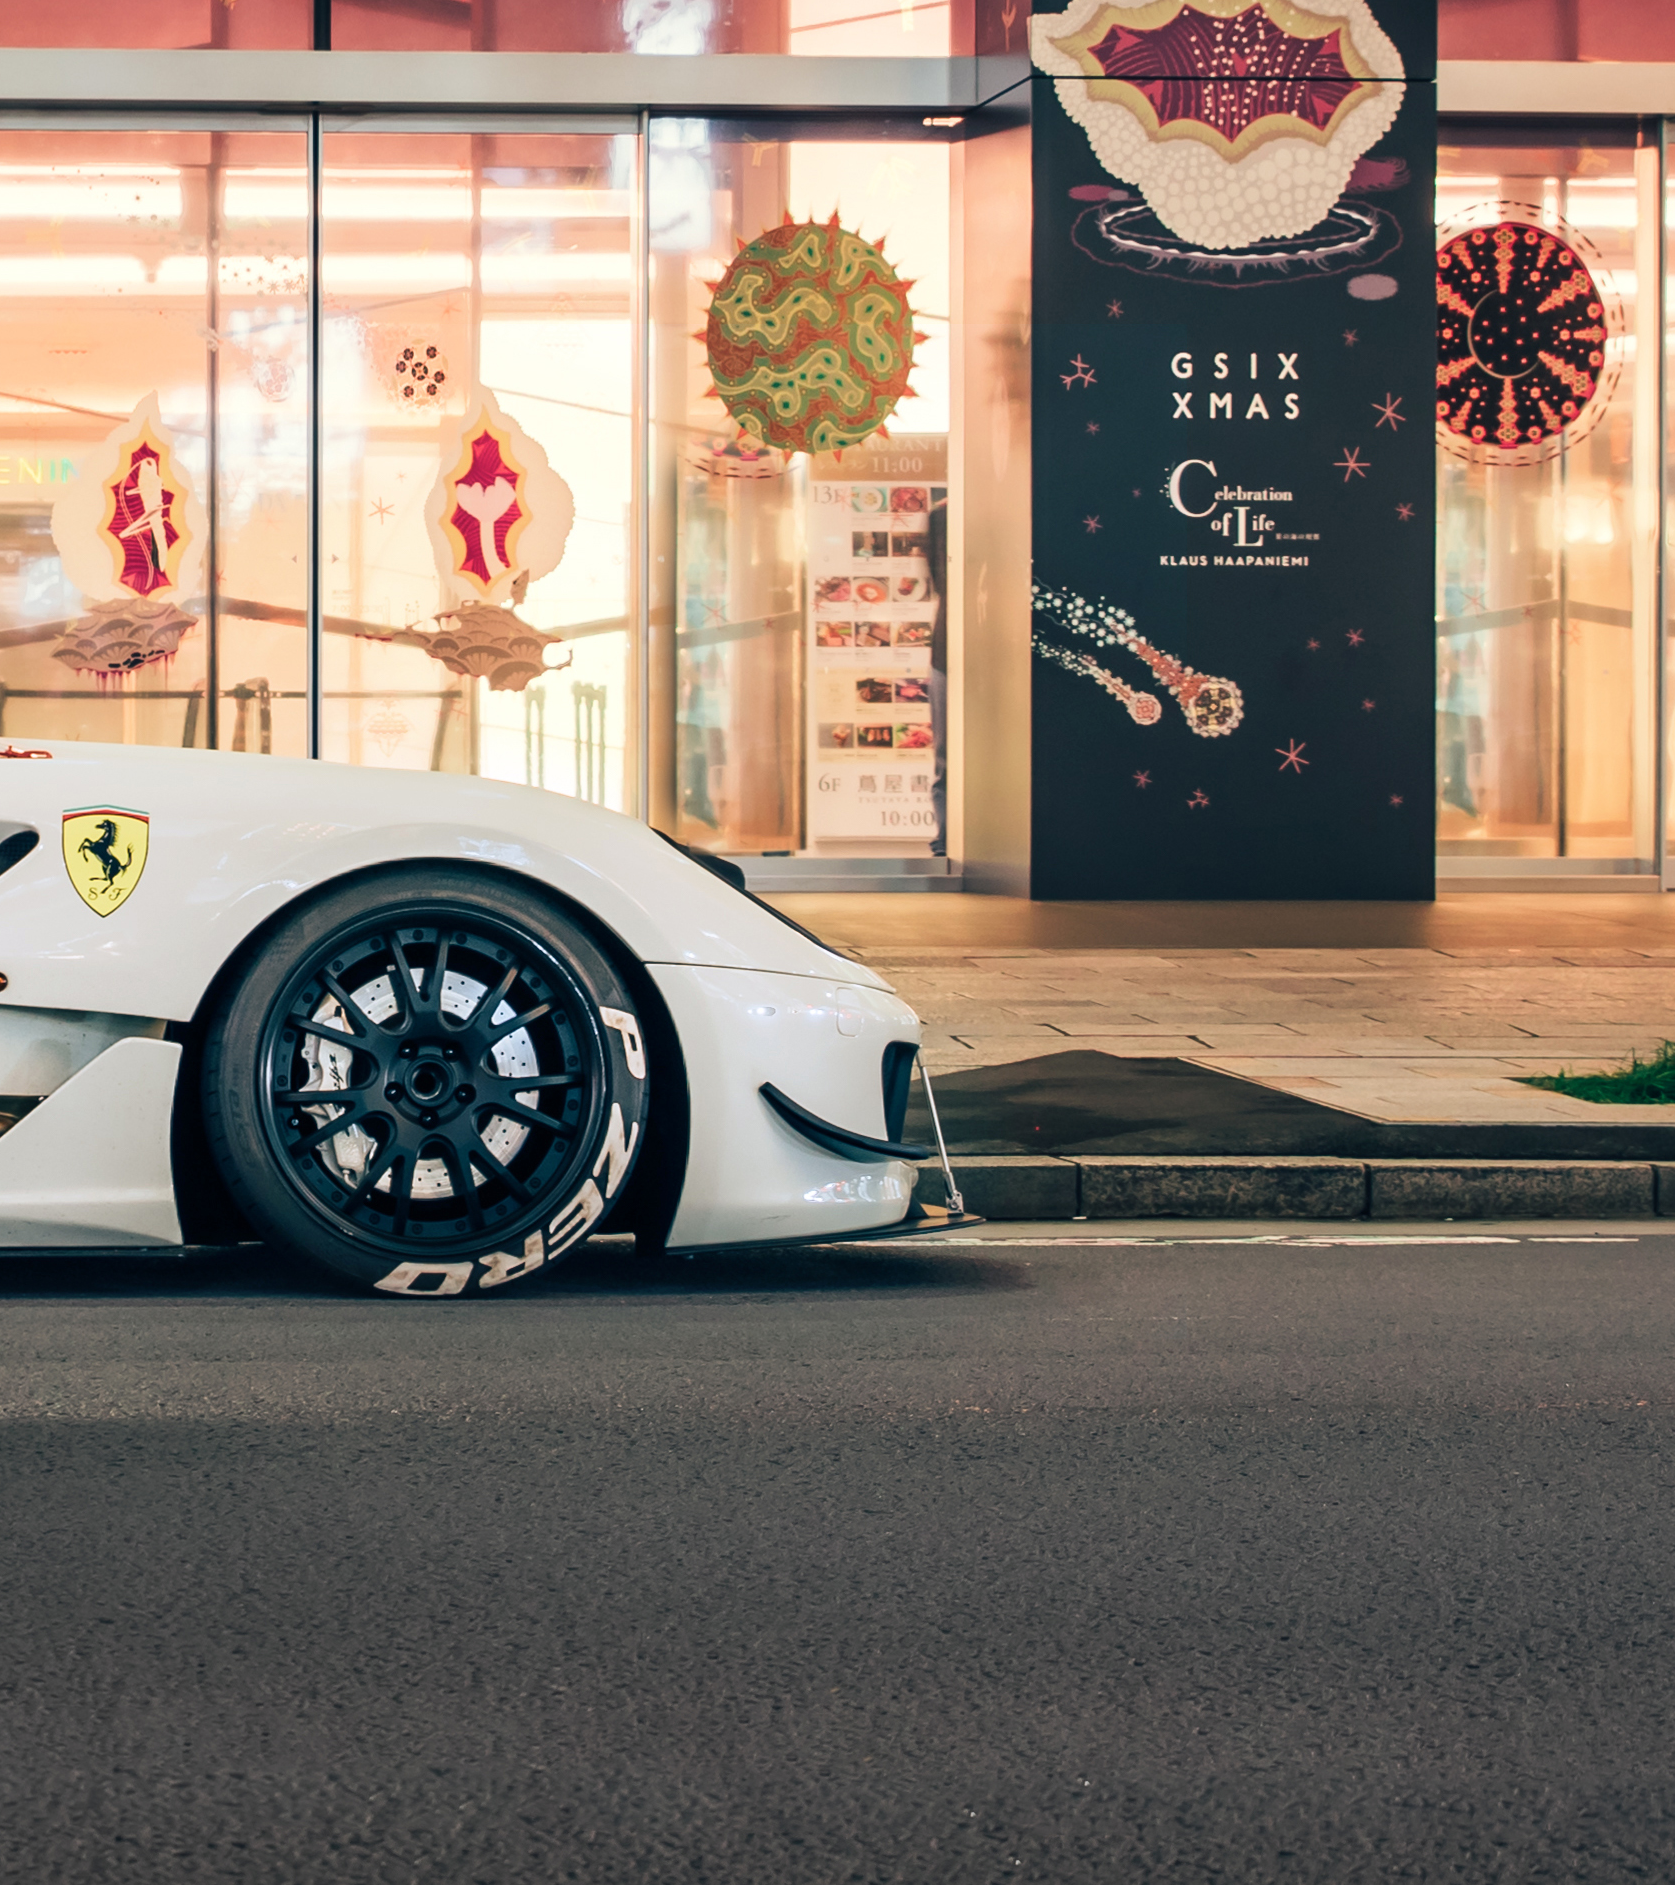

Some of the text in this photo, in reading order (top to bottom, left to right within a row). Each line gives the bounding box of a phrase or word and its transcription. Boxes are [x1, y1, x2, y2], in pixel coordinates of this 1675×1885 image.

[1170, 352, 1300, 380] GSIX
[1172, 392, 1301, 420] XMAS
[872, 456, 923, 473] 11:00
[1169, 459, 1293, 518] Celebration
[1210, 506, 1276, 547] of Life
[1159, 555, 1310, 567] KLAUS HAAPANIEMI
[818, 773, 930, 794] 6F 蔦屋書
[880, 810, 935, 826] 10:00
[599, 1005, 646, 1080] P
[375, 1102, 641, 1296] ZERO
